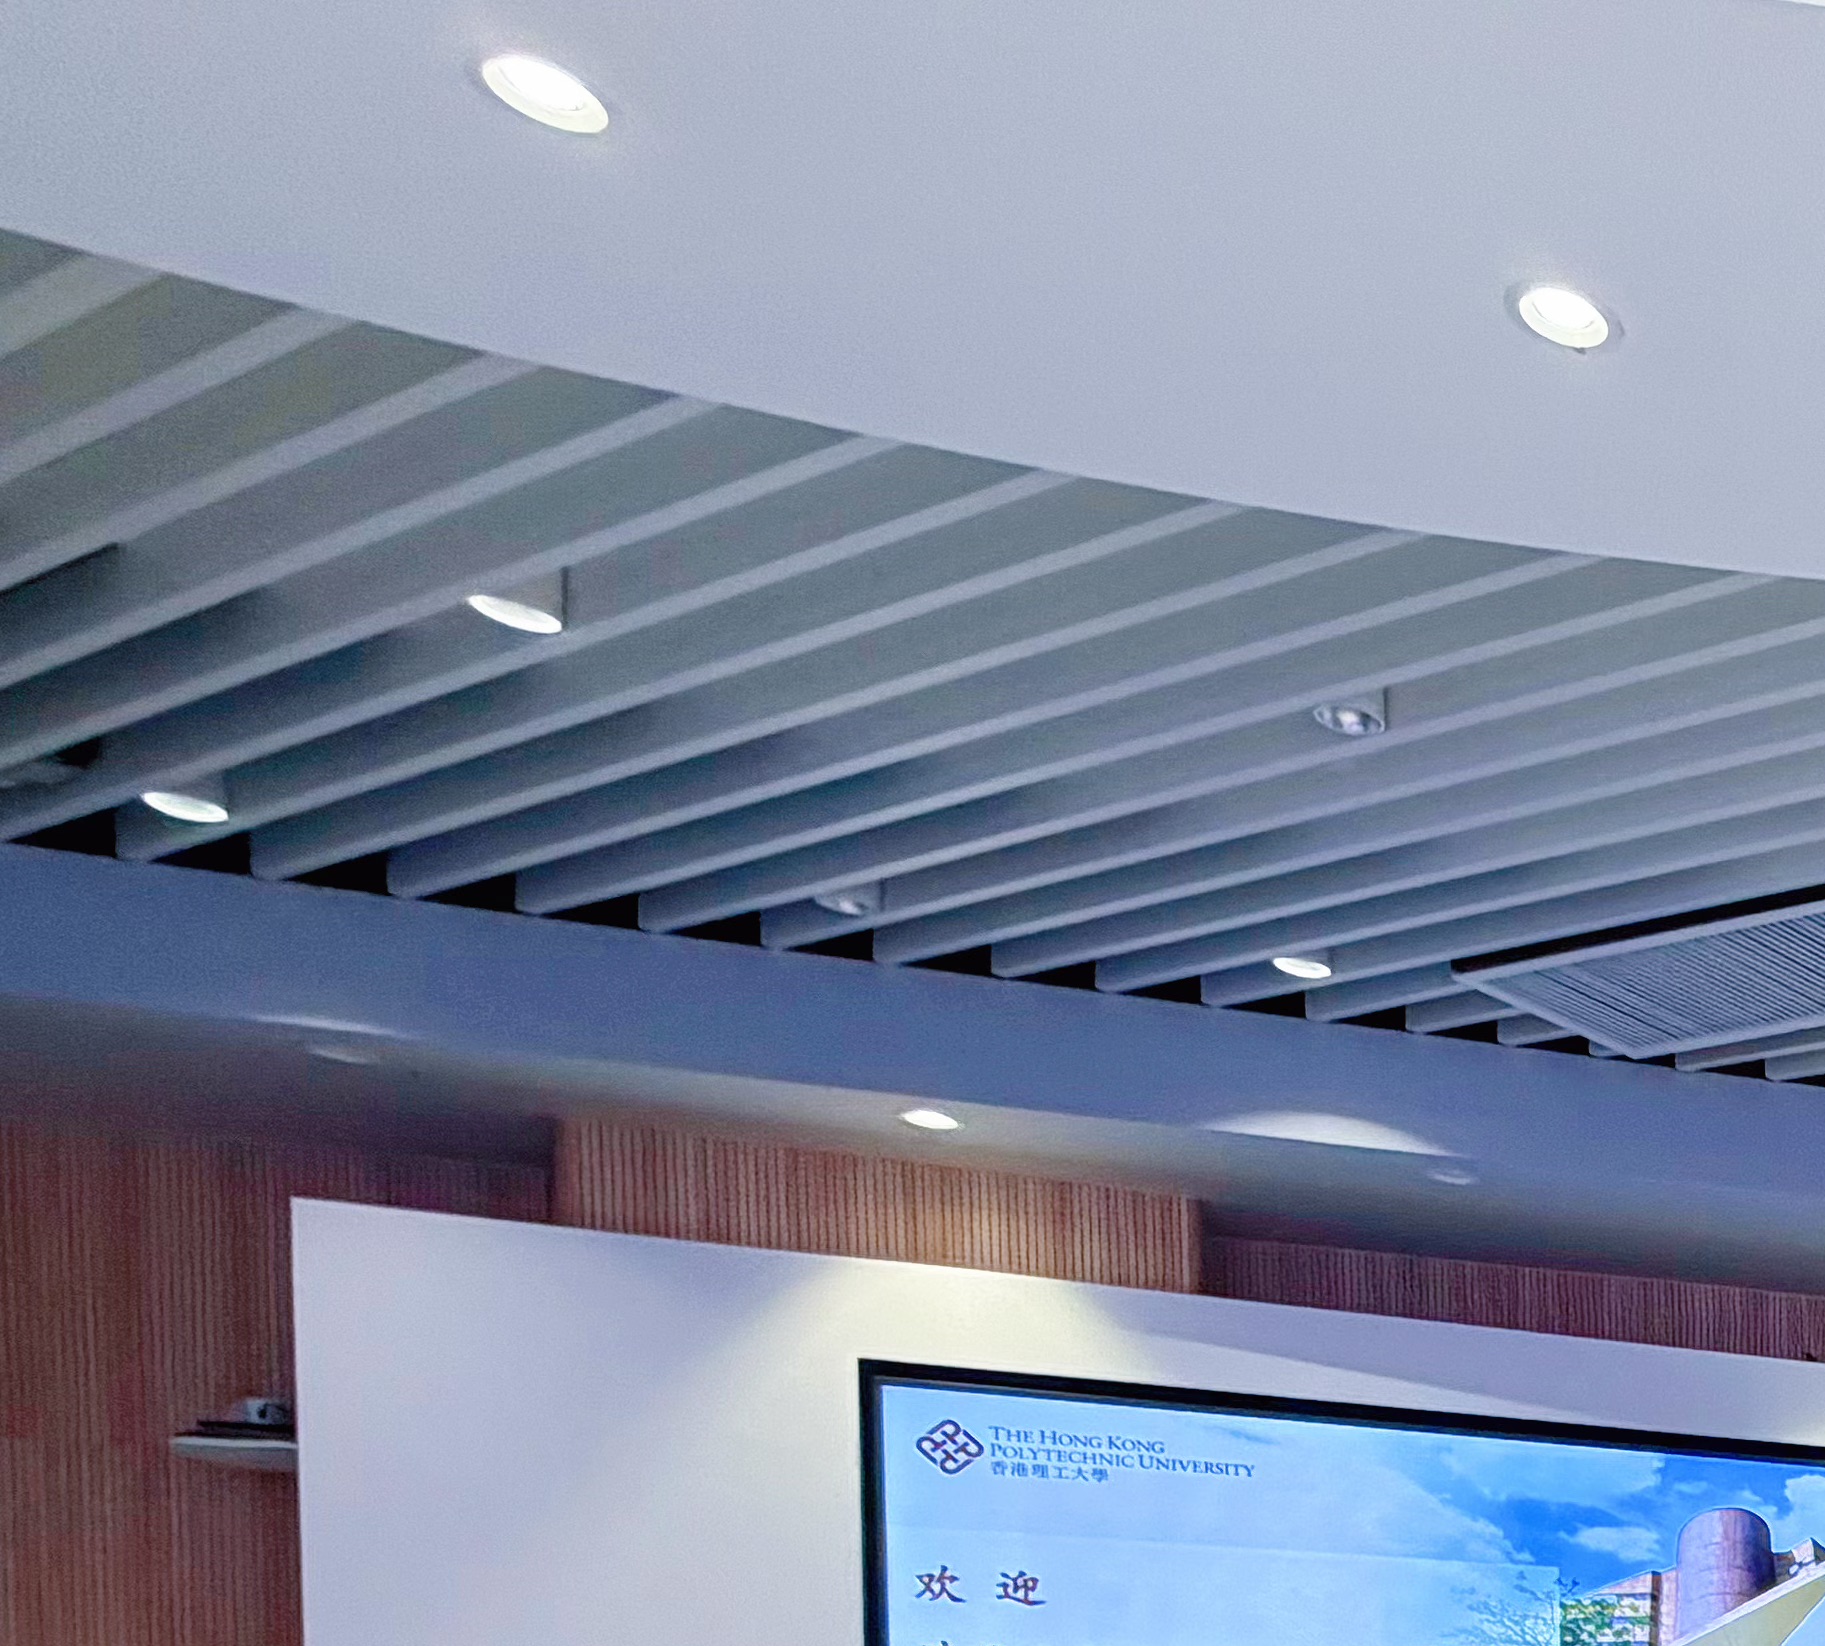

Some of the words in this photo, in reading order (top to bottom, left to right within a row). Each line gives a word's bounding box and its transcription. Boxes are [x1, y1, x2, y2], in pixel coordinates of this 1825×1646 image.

[988, 1425, 1034, 1443] THE
[1039, 1430, 1102, 1450] HONG
[1107, 1435, 1165, 1454] KONG
[990, 1443, 1135, 1468] POLYTECHNIC
[1138, 1456, 1255, 1477] UNIVERSITY
